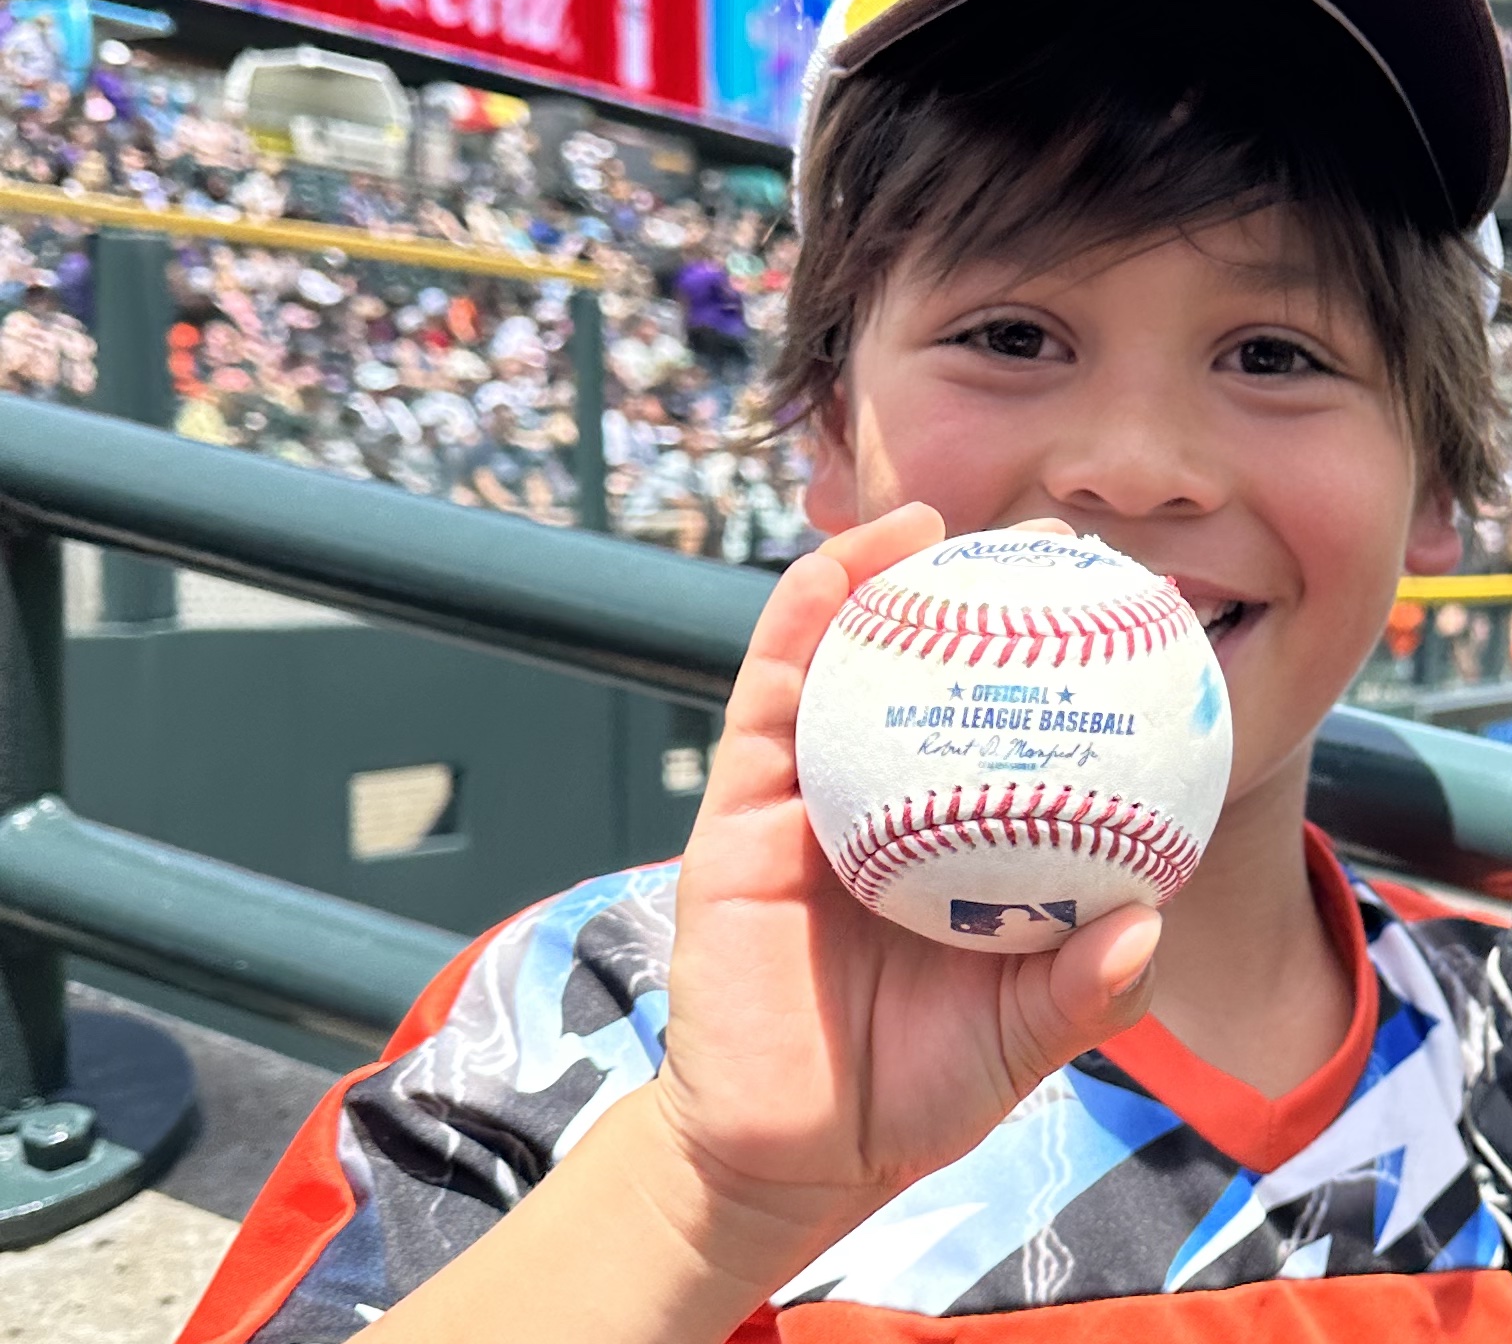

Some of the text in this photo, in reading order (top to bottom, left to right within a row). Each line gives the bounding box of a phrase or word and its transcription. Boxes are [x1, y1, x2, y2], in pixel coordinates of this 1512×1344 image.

[932, 539, 1123, 569] Rawlings
[972, 684, 1050, 705] OFFICIAL
[885, 706, 1136, 736] MAJOR LEAGUE BASEBALL
